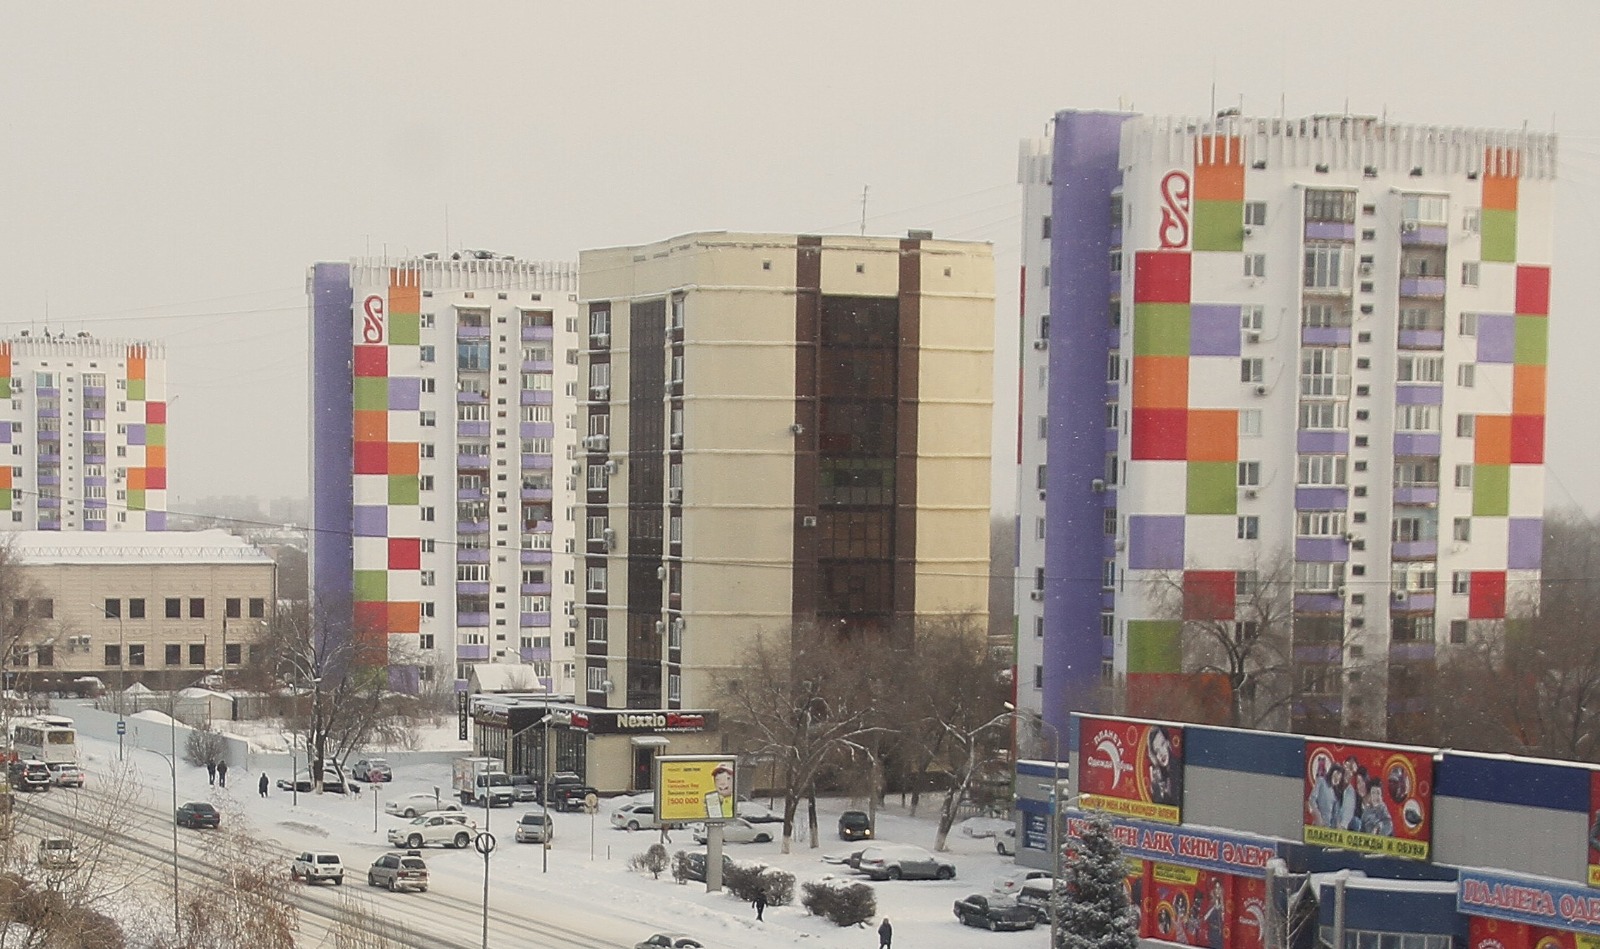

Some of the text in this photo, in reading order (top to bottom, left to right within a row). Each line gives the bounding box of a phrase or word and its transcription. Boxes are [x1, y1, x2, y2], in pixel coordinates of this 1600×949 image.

[617, 713, 666, 728] Nexxio
[1094, 729, 1125, 756] ПЛАНЕТА
[1142, 830, 1175, 856] АЯҚ
[1306, 828, 1425, 856] ПЛАНЕТА ОДЕЖДЫ И ОБУВИ
[1463, 878, 1557, 916] ПЛАНЕТА
